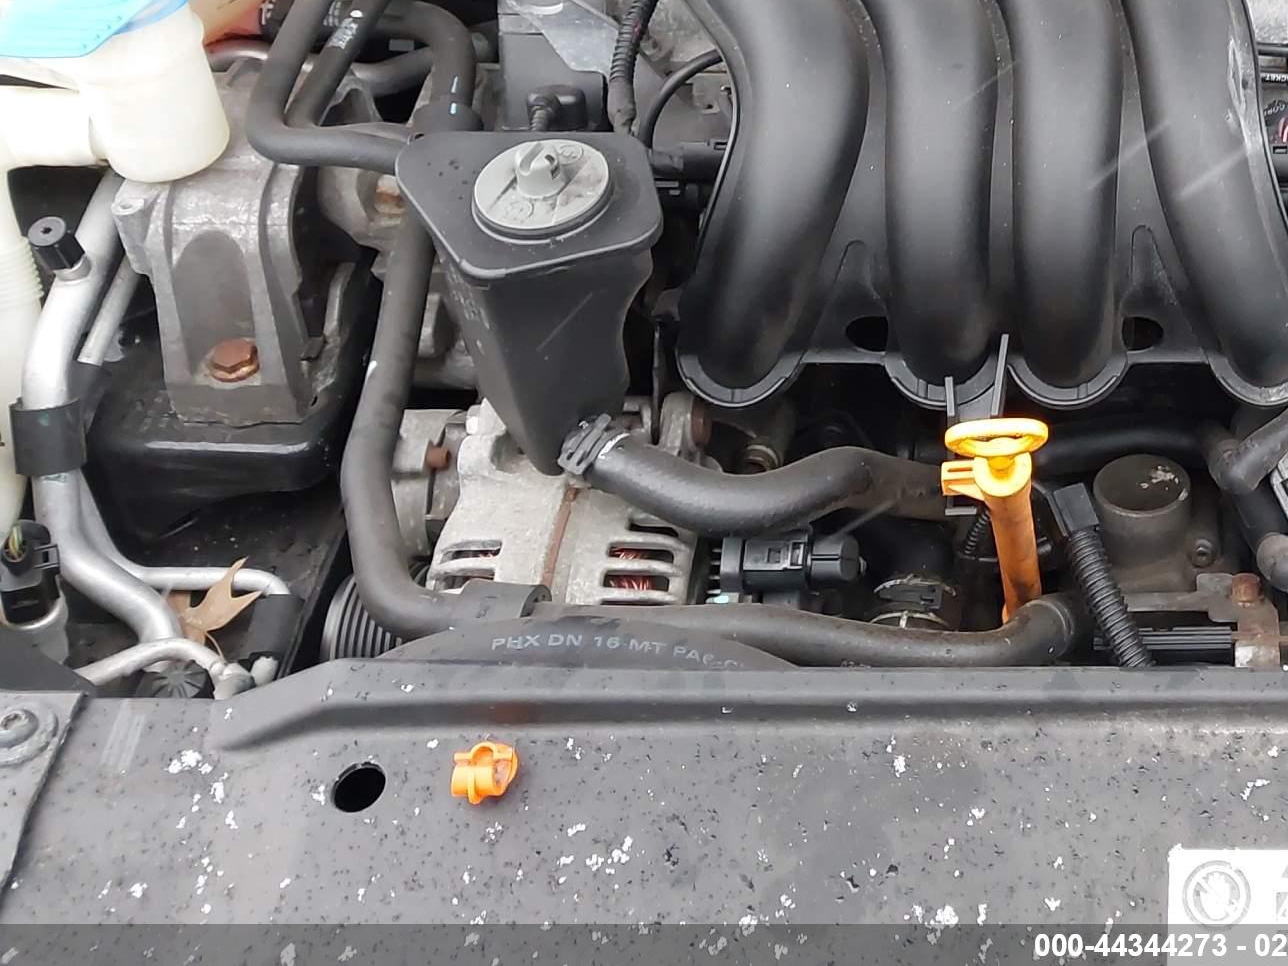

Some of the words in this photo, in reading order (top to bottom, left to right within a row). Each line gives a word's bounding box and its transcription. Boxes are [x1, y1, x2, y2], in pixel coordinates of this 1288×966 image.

[491, 634, 541, 651] PHX
[547, 633, 583, 647] DN
[594, 636, 621, 649] 16
